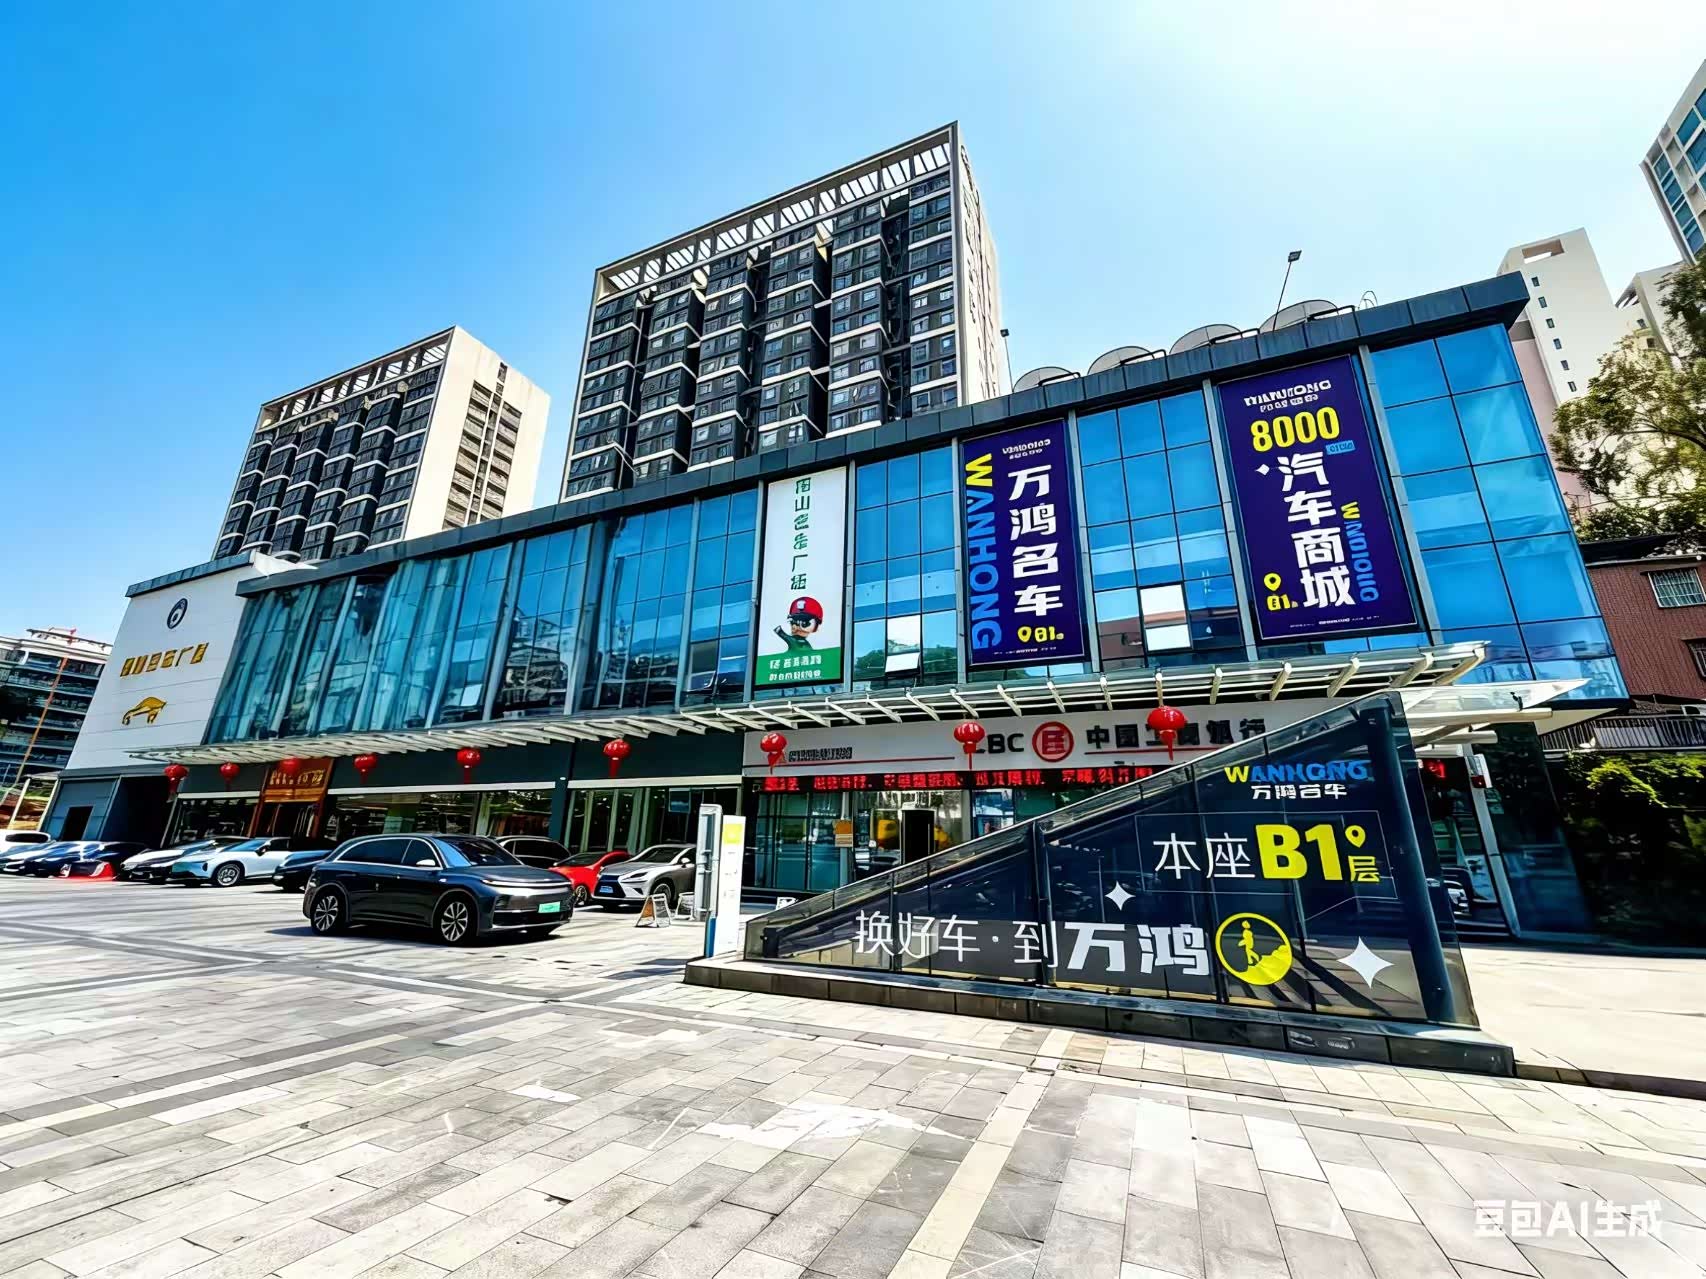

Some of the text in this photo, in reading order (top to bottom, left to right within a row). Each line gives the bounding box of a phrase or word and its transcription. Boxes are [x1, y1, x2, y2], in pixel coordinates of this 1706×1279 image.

[1250, 406, 1340, 452] 8000
[965, 453, 1003, 649] WANHONG
[1007, 464, 1064, 616] 万鸿名车
[1276, 452, 1356, 608] 汽车商城
